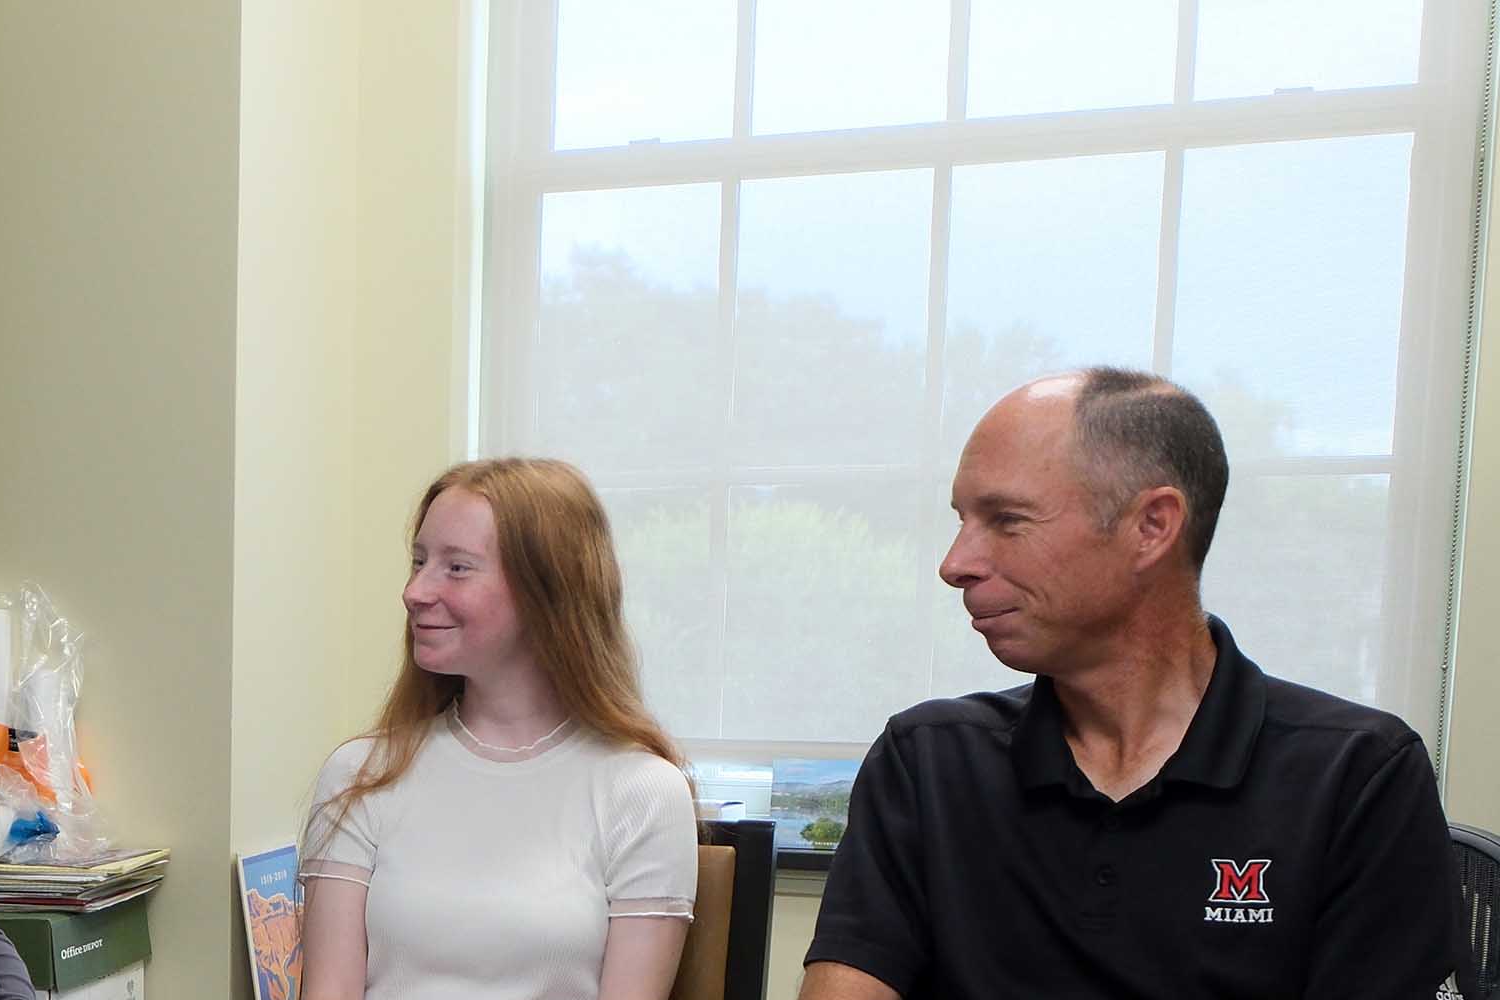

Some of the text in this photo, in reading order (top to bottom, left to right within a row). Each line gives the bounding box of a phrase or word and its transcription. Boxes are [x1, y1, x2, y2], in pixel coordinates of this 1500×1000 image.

[1208, 858, 1272, 903] M
[1203, 907, 1274, 923] MIAMI
[60, 938, 103, 960] Office DEPOT
